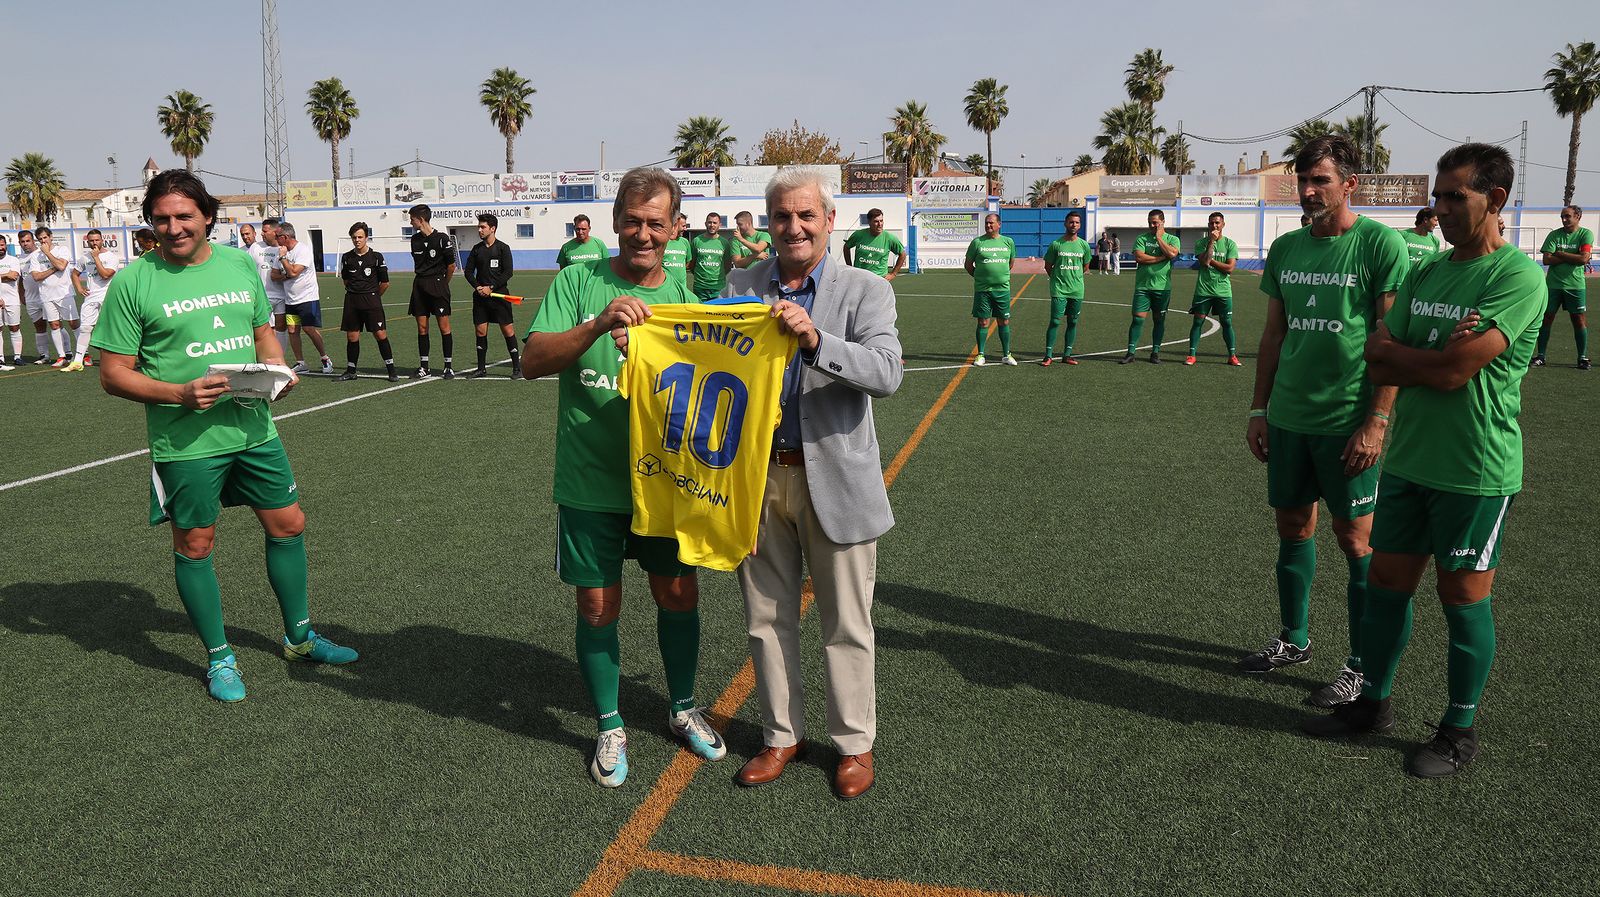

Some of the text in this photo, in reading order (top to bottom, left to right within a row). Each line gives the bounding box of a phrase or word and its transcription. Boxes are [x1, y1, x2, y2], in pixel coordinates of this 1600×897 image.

[854, 170, 898, 181] Virginia
[1111, 179, 1134, 187] Grupo
[463, 209, 473, 218] DE
[1280, 270, 1358, 287] HOMENAJE
[163, 291, 251, 318] HOMENAJE
[1306, 294, 1316, 307] A
[213, 315, 226, 329] A
[673, 321, 755, 357] CANITO
[1428, 328, 1439, 342] A
[185, 334, 252, 358] CANITO
[653, 361, 749, 470] 10
